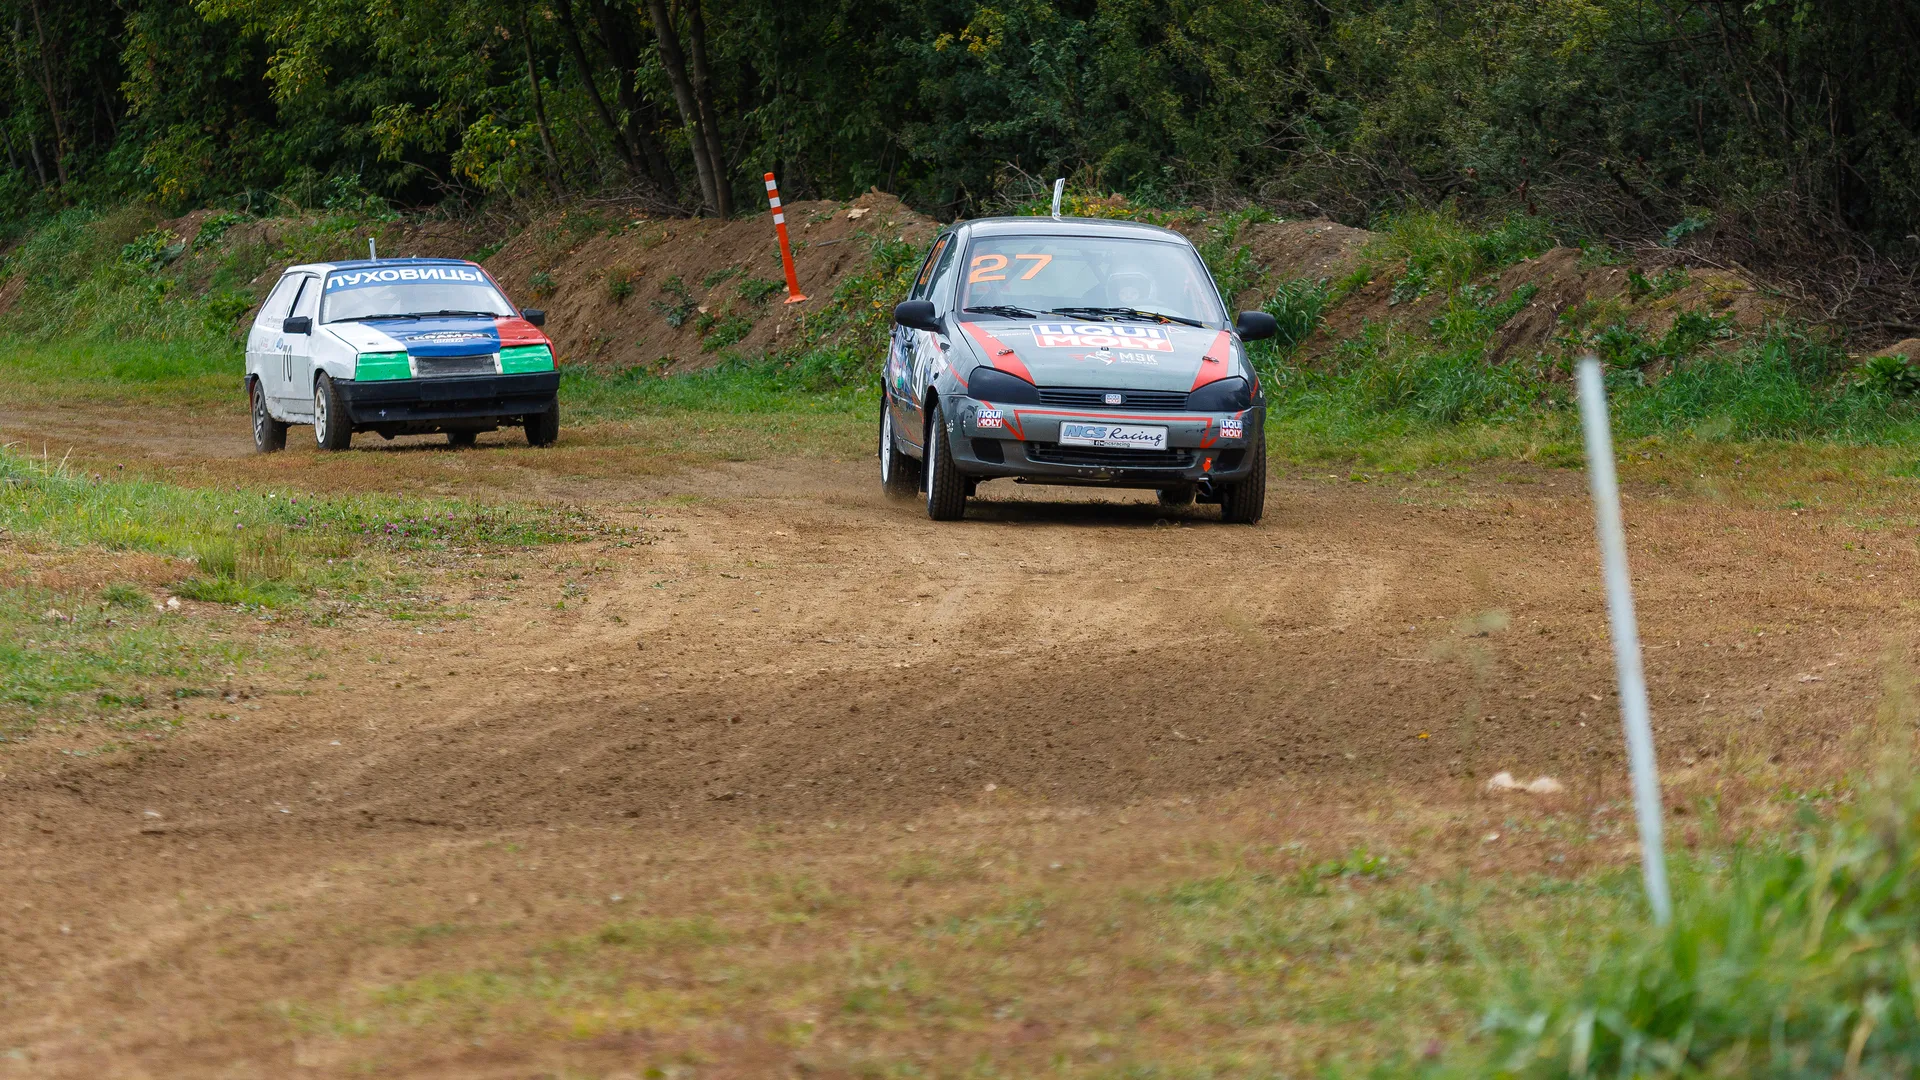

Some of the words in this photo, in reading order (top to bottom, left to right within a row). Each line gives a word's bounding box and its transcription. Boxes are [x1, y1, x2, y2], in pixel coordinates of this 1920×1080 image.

[969, 254, 1053, 284] 27
[326, 268, 484, 289] ЛУХОВИЦЫ
[1039, 325, 1161, 339] LIQUI
[1042, 335, 1166, 349] MOLY
[1119, 352, 1157, 362] MSK
[1063, 425, 1107, 439] NCS
[1109, 427, 1163, 447] Racing
[1222, 428, 1242, 438] MOLY
